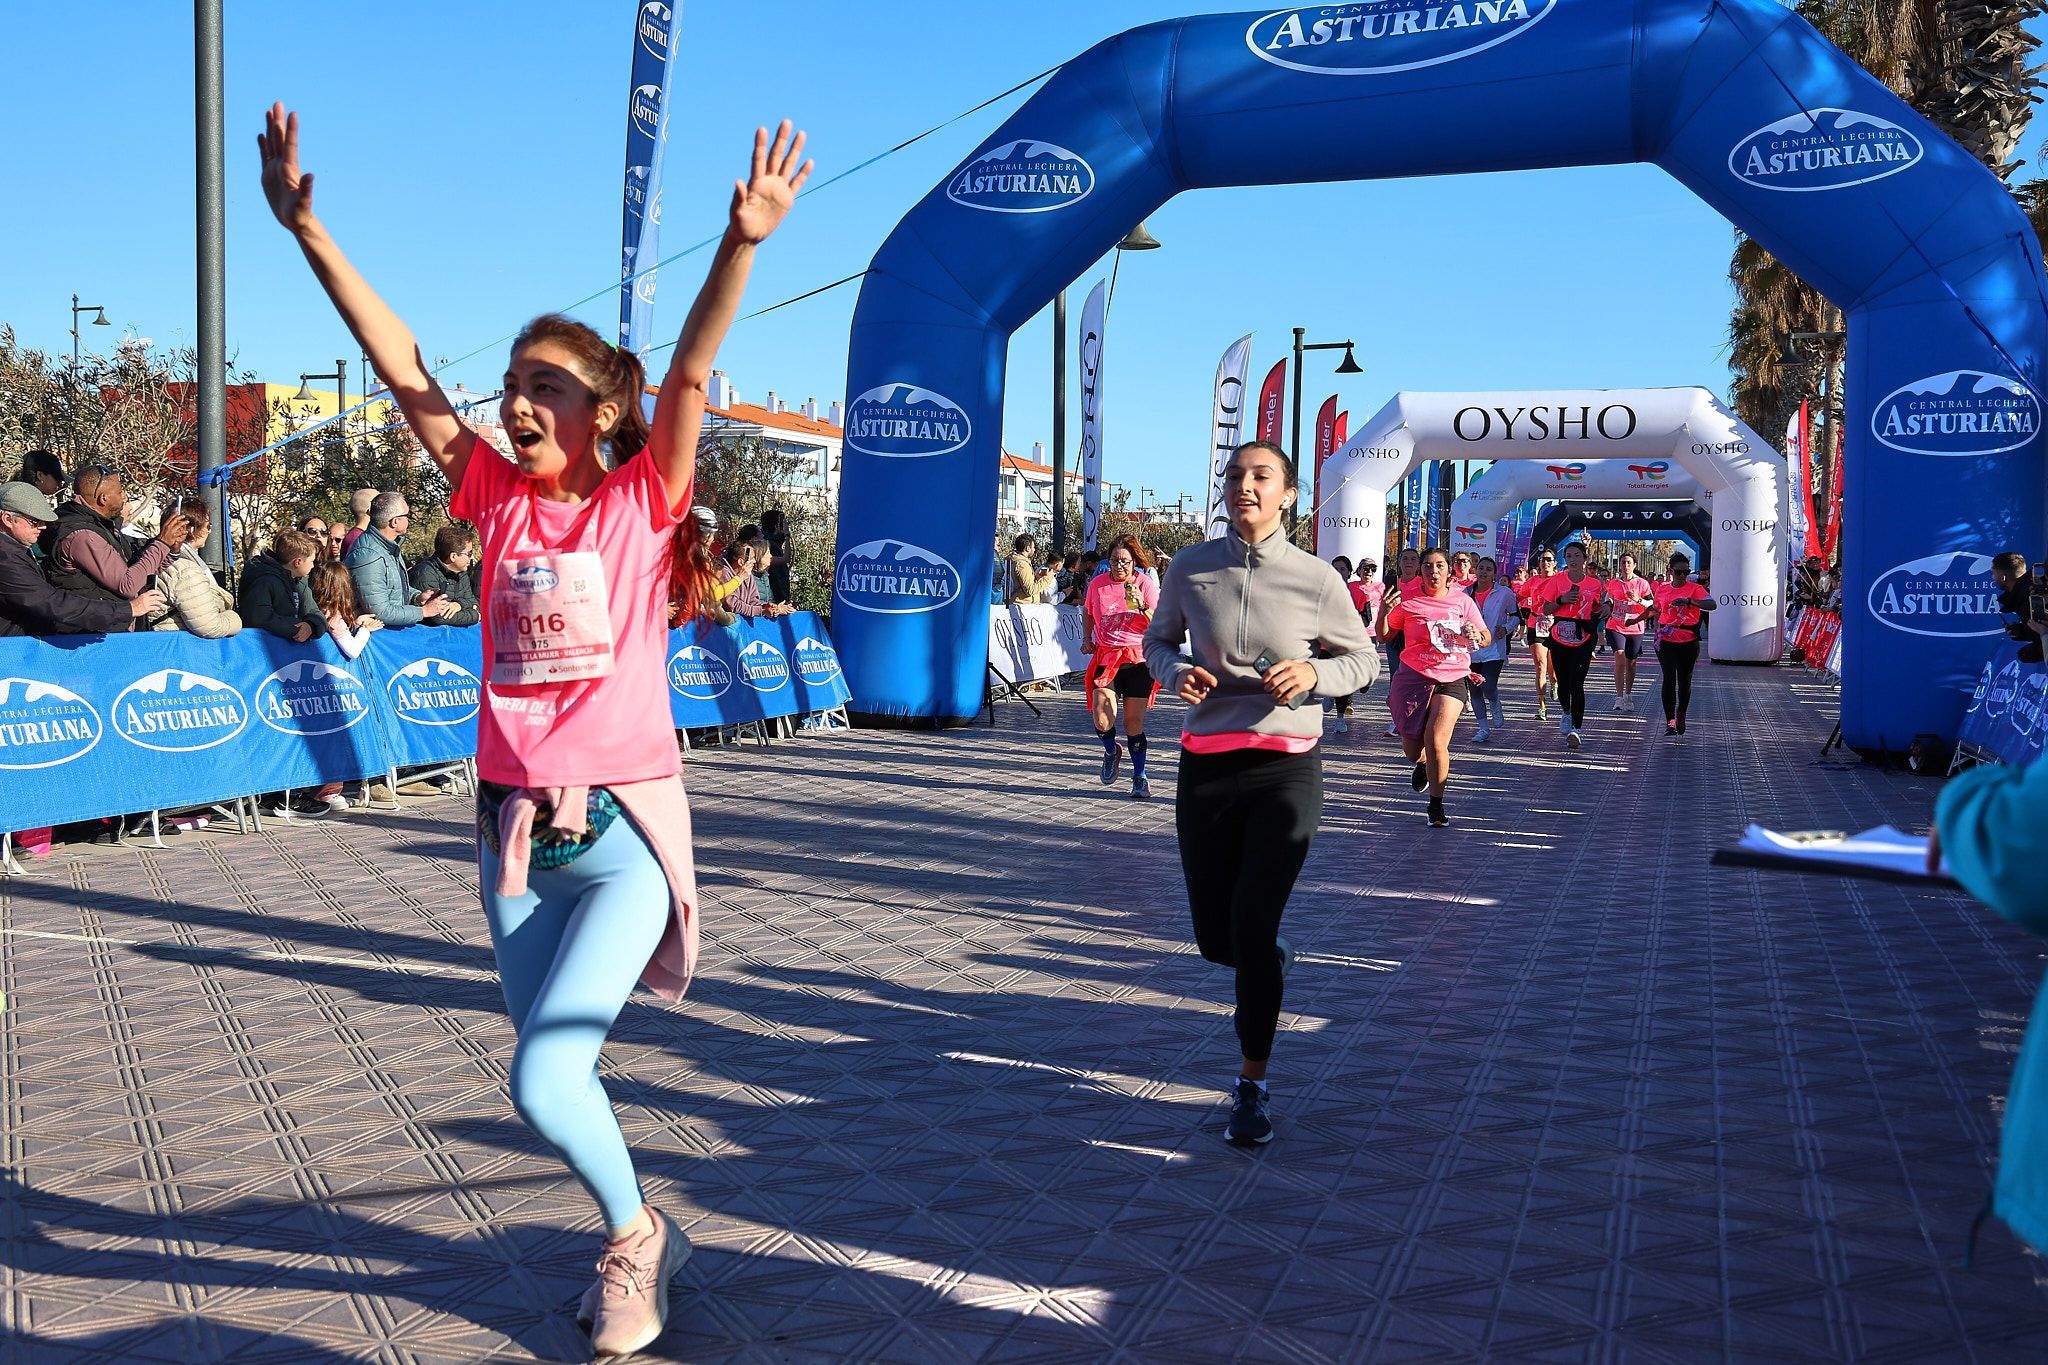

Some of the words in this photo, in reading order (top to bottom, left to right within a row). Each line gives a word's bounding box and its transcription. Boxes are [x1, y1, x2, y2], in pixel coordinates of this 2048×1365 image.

[1265, 0, 1531, 50] ASTURIANA
[1771, 135, 1835, 150] CENTRAL
[1841, 131, 1902, 142] LECHERA
[1743, 142, 1912, 176] ASTURIANA
[979, 163, 1023, 174] CENTRAL
[1028, 162, 1078, 171] LECHERA
[954, 170, 1083, 196] ASTURIANA
[1909, 400, 1972, 410] CENTRAL
[1978, 398, 2031, 408] LECHERA
[863, 408, 905, 417] CENTRAL
[909, 409, 958, 420] LECHERA
[1882, 404, 2034, 437] ASTURIANA
[849, 410, 961, 442] ASTURIANA
[1453, 405, 1638, 442] OYSHO
[1348, 447, 1400, 460] OYSHO
[1691, 442, 1749, 456] OYSHO
[1545, 483, 1587, 491] TotalEnergies
[1323, 517, 1370, 529] OYSHO
[1582, 511, 1674, 520] VOLVO
[1721, 519, 1776, 532] OYSHO
[852, 562, 894, 572] CENTRAL
[899, 565, 948, 576] LECHERA
[839, 564, 950, 598] ASTURIANA
[1905, 580, 1968, 590] CENTRAL
[1719, 594, 1774, 607] OYSHO
[518, 613, 565, 635] 016
[531, 640, 549, 649] 975
[674, 664, 729, 686] ASTURIANA
[742, 661, 786, 680] ASTURIANA
[141, 697, 185, 709] CENTRAL
[187, 693, 232, 704] LECHERA
[268, 690, 363, 720] ASTURIANA
[397, 684, 480, 712] ASTURIANA
[0, 709, 29, 719] TRAL
[33, 704, 83, 717] LECHERA
[126, 702, 241, 735] ASTURIANA
